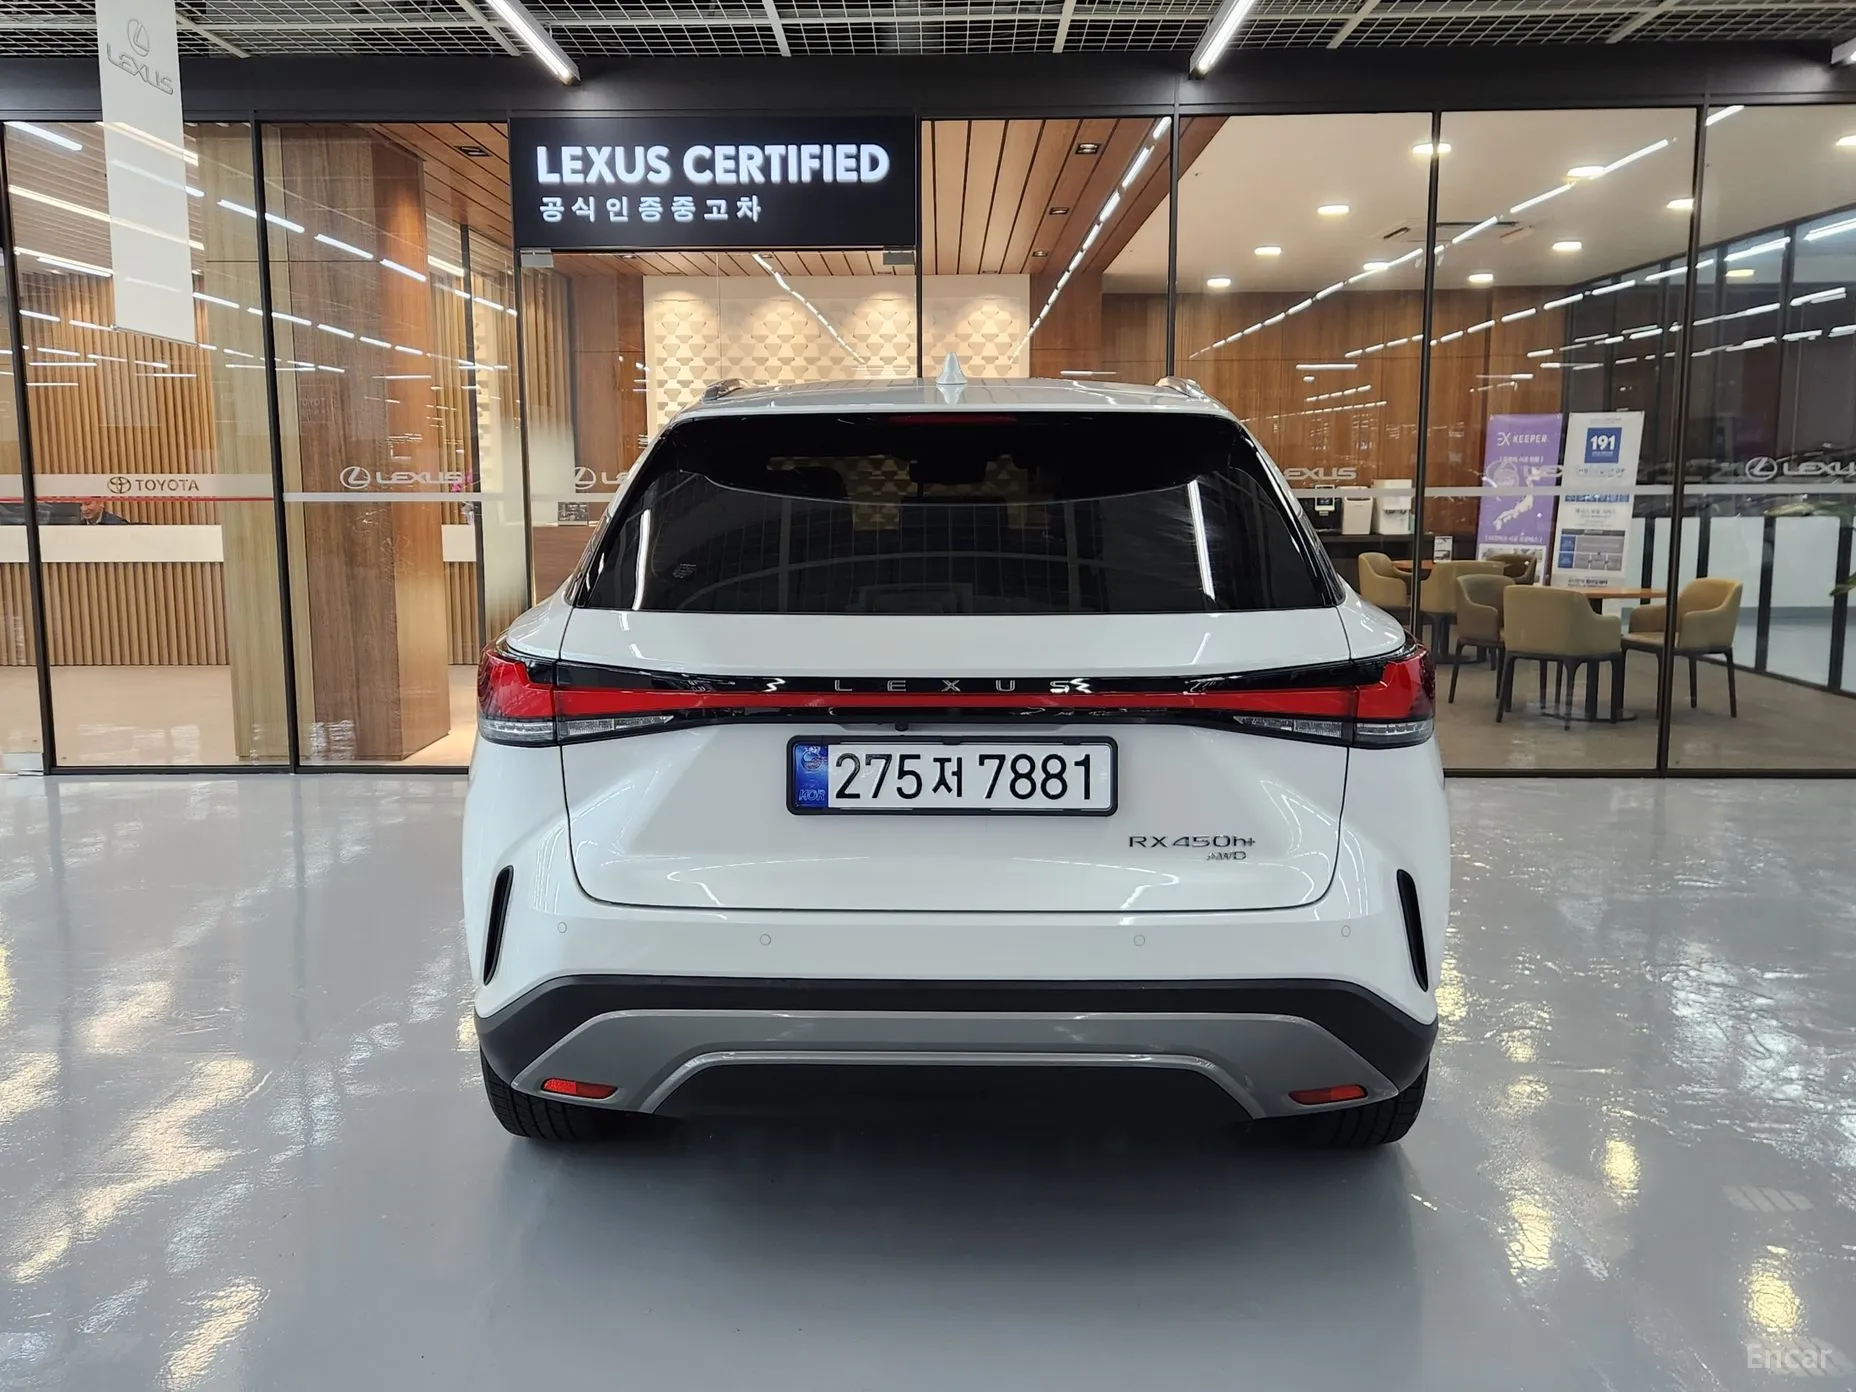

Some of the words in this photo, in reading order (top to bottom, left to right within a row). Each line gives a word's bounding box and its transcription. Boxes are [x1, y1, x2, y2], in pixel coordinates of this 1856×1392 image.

[106, 42, 174, 96] LEXUS
[536, 145, 671, 184] LEXUS
[683, 143, 890, 184] CERTIFIED
[1512, 433, 1549, 444] KEEPER
[1590, 434, 1615, 450] 191
[1283, 467, 1357, 480] EXUS
[1783, 461, 1856, 476] LEXU
[376, 471, 464, 484] LEXUS
[135, 479, 199, 491] TOYOTA
[834, 679, 1071, 693] LEXUS
